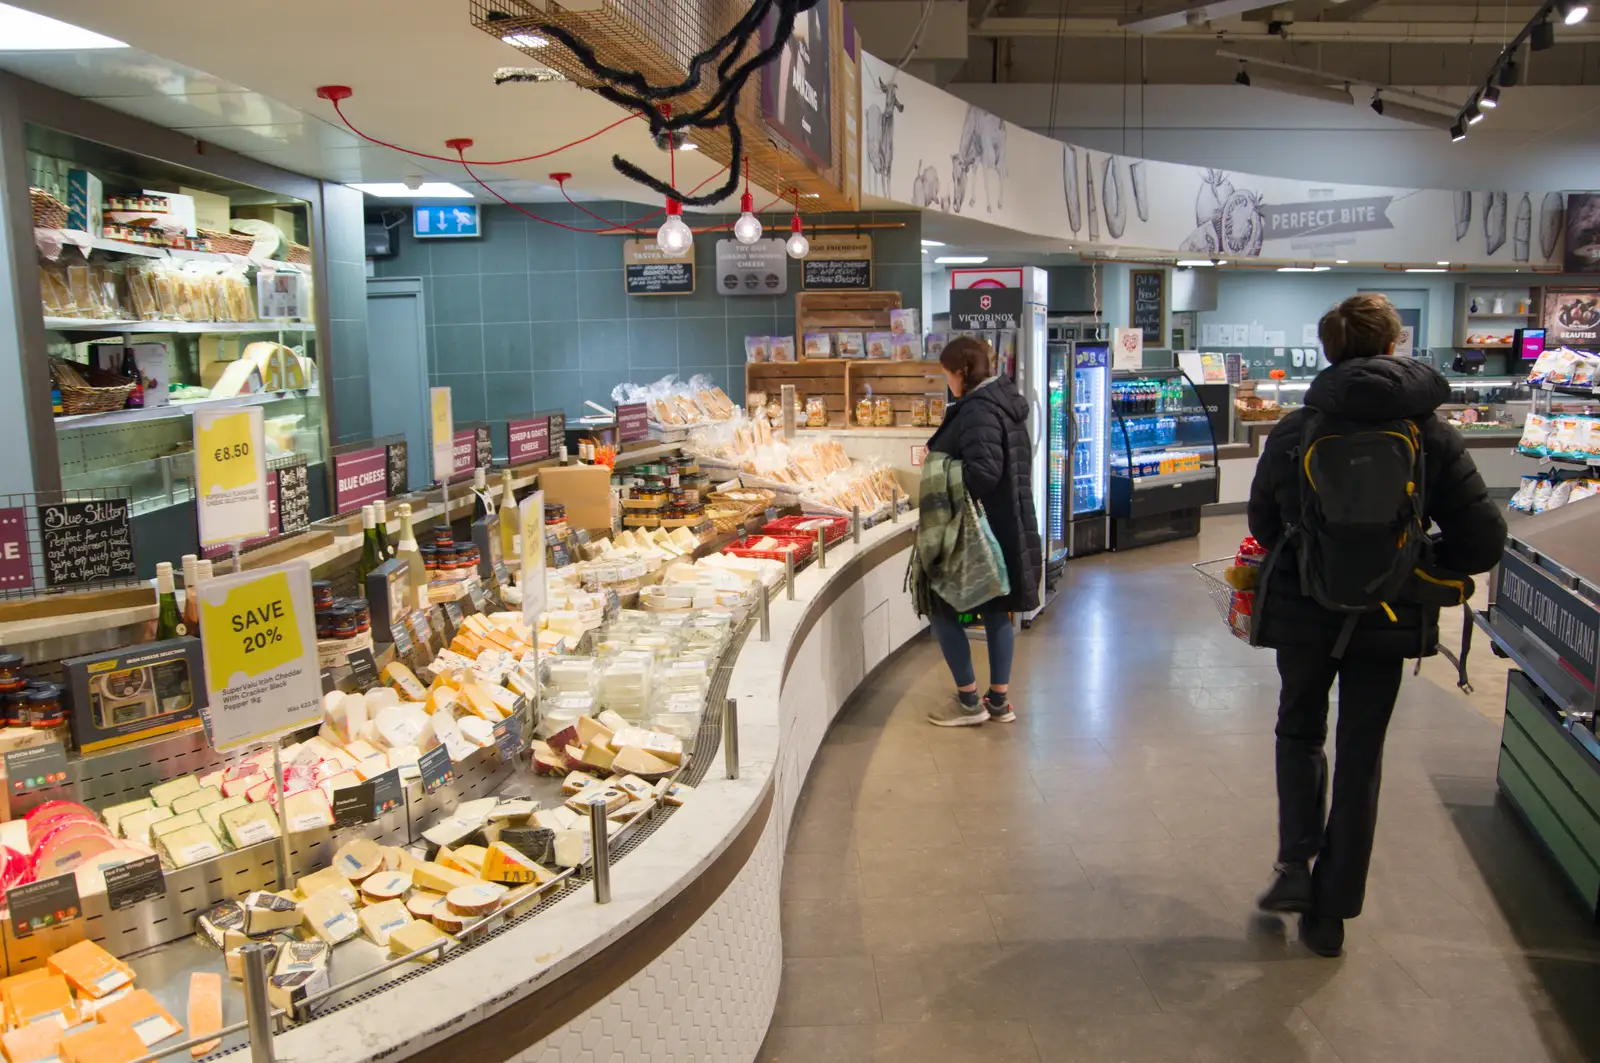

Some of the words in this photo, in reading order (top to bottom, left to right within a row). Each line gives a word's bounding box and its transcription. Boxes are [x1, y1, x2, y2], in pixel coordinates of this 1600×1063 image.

[1272, 208, 1335, 230] PERFECT
[1340, 206, 1376, 224] BITE
[958, 313, 1014, 322] VICTORINOX
[1560, 331, 1597, 339] BEAUTIES
[510, 431, 527, 443] SHEEP
[520, 440, 539, 452] CHEESE
[214, 442, 249, 463] €8.50
[339, 475, 359, 493] BLUE
[359, 468, 386, 487] CHEESE
[45, 507, 84, 529] Blue
[85, 502, 128, 527] Stilton
[45, 531, 82, 549] Perfect
[85, 529, 99, 541] for
[48, 549, 65, 561] and
[89, 552, 109, 565] with
[54, 569, 69, 583] for
[231, 600, 285, 633] SAVE
[1502, 567, 1534, 617] AUTENTICA
[1533, 589, 1559, 637] CUCINA
[1558, 606, 1596, 665] ITALIANA
[242, 626, 283, 654] 20%
[221, 681, 258, 696] SuperValu
[258, 676, 274, 686] Irish
[274, 668, 303, 681] Cheddar
[222, 694, 240, 704] With
[241, 686, 269, 699] Cracker
[269, 680, 287, 691] Black
[223, 700, 249, 712] Pepper
